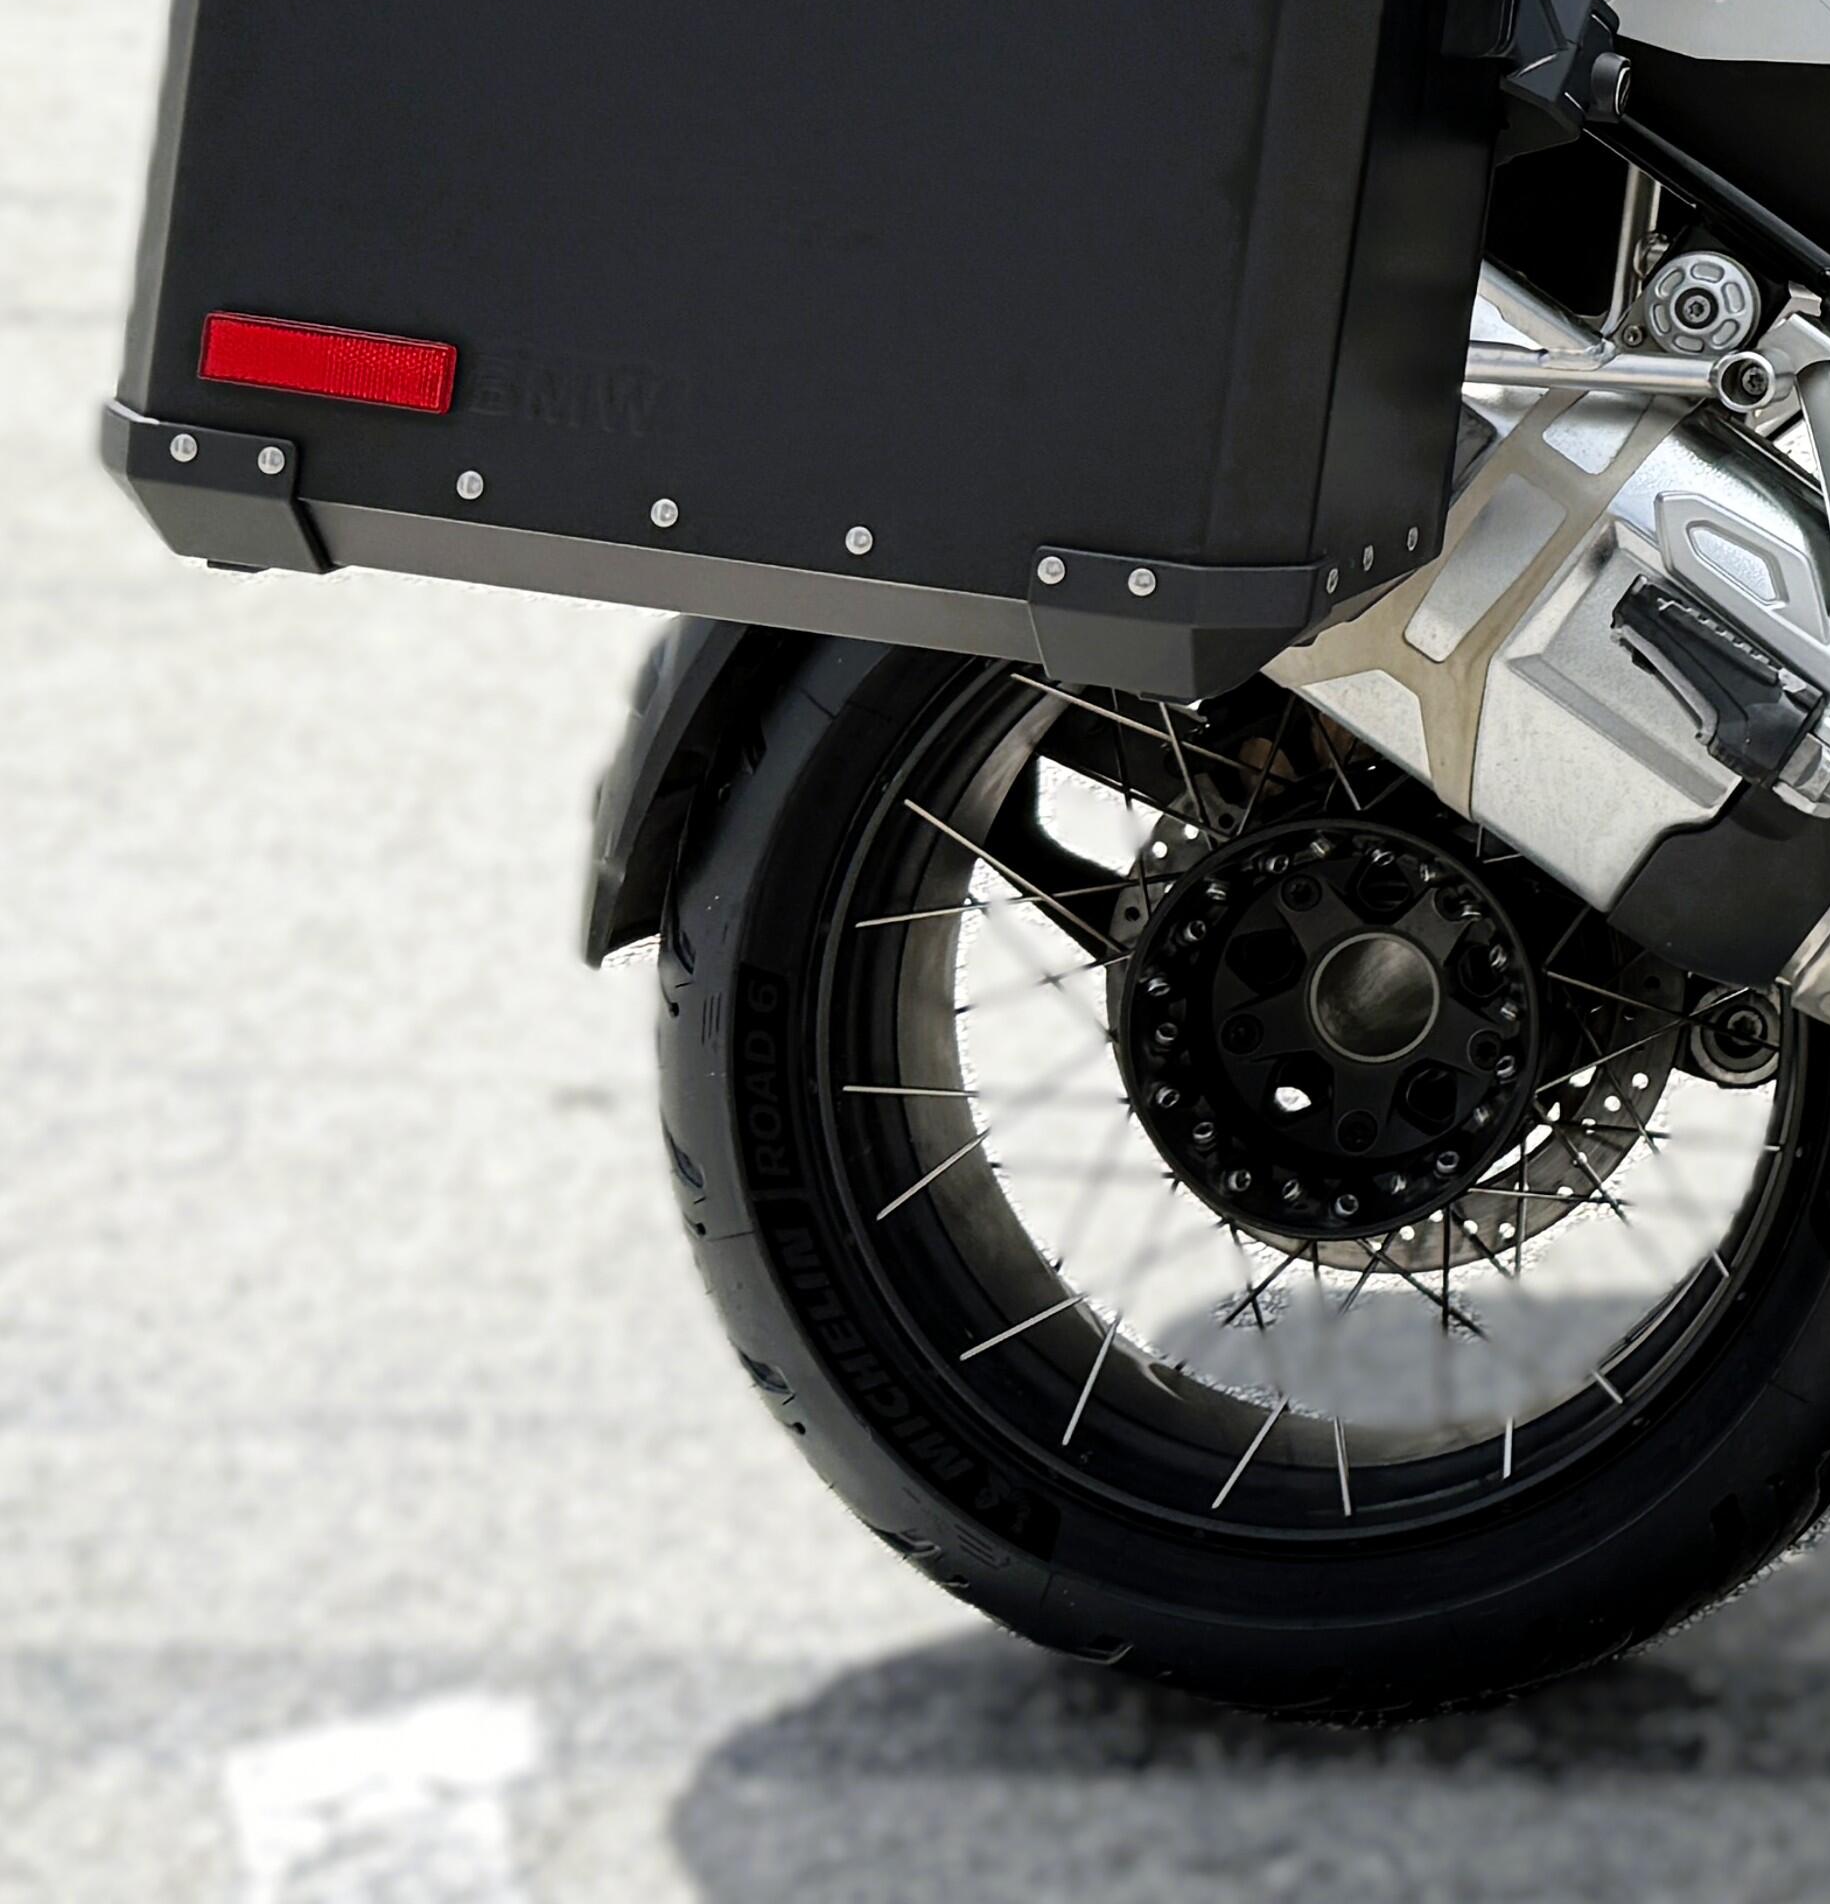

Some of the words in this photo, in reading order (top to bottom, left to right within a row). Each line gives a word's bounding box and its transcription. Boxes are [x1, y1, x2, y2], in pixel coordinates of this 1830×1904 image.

[746, 978, 778, 1012] 6
[743, 1034, 790, 1177] ROAD
[775, 1224, 975, 1482] MICHELIN
